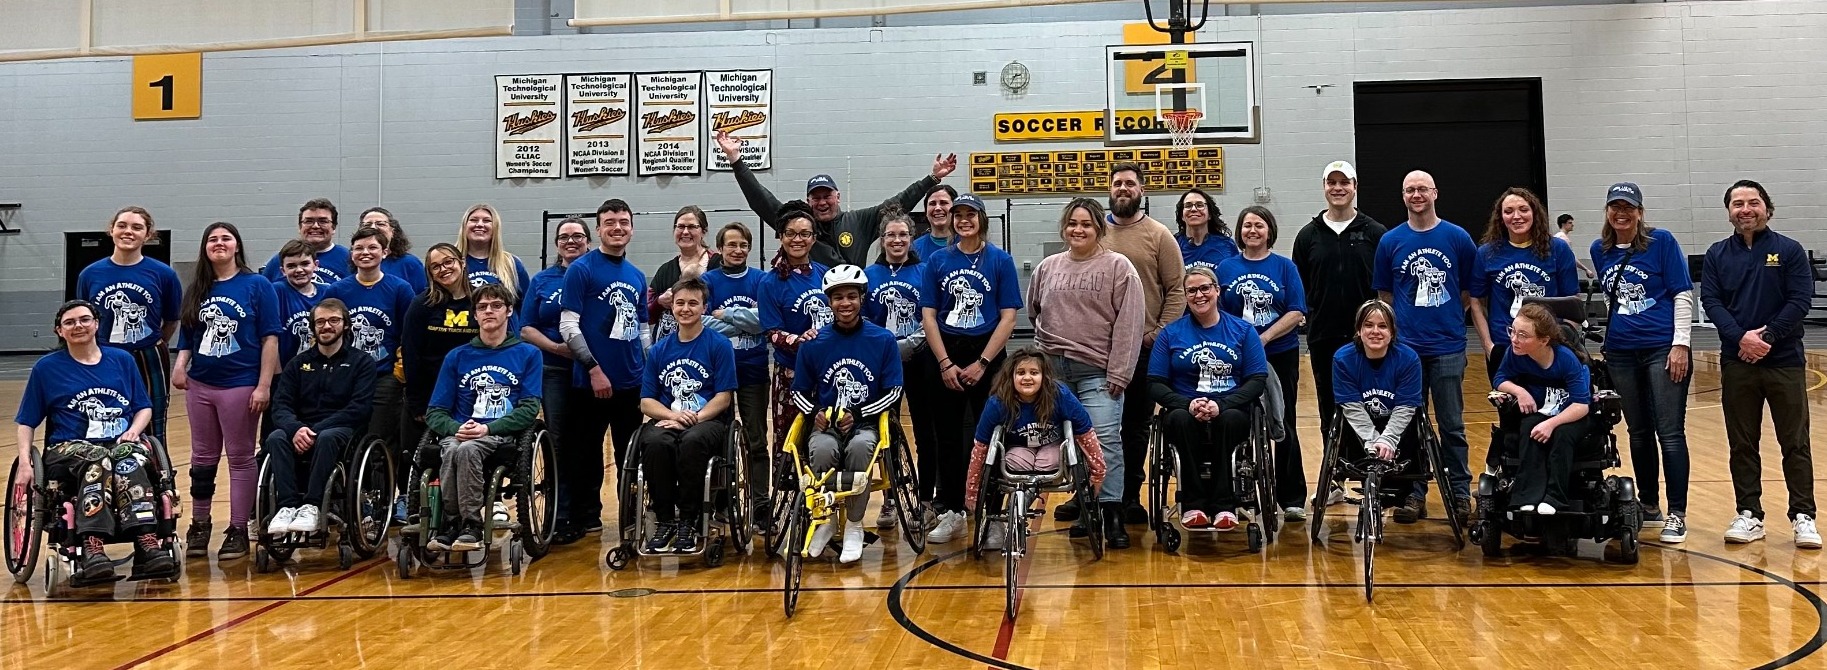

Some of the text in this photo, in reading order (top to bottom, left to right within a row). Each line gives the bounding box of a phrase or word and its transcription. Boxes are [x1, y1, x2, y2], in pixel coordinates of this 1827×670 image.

[720, 73, 757, 83] Michigan
[149, 75, 173, 110] 1
[710, 83, 767, 93] Technological
[718, 94, 759, 103] University
[502, 110, 557, 134] Huskies
[571, 106, 626, 130] Huskies
[641, 108, 695, 132] Huskies
[712, 110, 766, 132] Huskies
[998, 118, 1082, 134] SOCCER
[1401, 259, 1409, 270] AM
[1408, 252, 1417, 260] AN
[1417, 248, 1442, 259] ATHLETE
[1441, 256, 1452, 269] TOO
[1766, 253, 1779, 262] M
[942, 276, 951, 288] AM
[949, 270, 959, 278] AN
[959, 268, 982, 280] ATHLETE
[981, 278, 992, 292] TOO
[1497, 271, 1505, 280] AM
[1504, 265, 1514, 273] AN
[1514, 263, 1541, 273] ATHLETE
[1614, 264, 1636, 273] ATLETE
[1635, 269, 1648, 280] TOO
[872, 287, 881, 298] AM
[890, 280, 912, 290] ATHLETE
[1050, 271, 1106, 292] CHATEAU
[1247, 273, 1270, 282] ATHLETE
[1268, 280, 1280, 292] TOO
[96, 291, 105, 301] AM
[117, 282, 144, 293] ATHLETE
[144, 291, 153, 304] TOO
[602, 286, 611, 298] AM
[794, 297, 803, 309] AM
[800, 291, 808, 300] AN
[210, 296, 236, 307] ATHLETE
[234, 304, 246, 318] TOO
[724, 298, 733, 307] AN
[358, 306, 384, 317] ATHLETE
[381, 312, 392, 326] TOO
[444, 309, 469, 327] M
[1183, 348, 1194, 356] AM
[1202, 341, 1226, 350] ATHLETE
[1226, 347, 1238, 360] TOO
[461, 373, 471, 384] AM
[481, 365, 509, 375] ATHLETE
[506, 372, 519, 385] TOO
[658, 358, 709, 380] AM AN ATHLETE TOO
[824, 368, 833, 380] AM
[832, 360, 842, 370] AN
[840, 358, 864, 370] ATHLETE
[862, 367, 874, 382] TOO
[77, 391, 88, 400] AN
[88, 388, 117, 398] ATHLETE
[116, 394, 129, 406] TOO
[1362, 388, 1396, 400] AN ATHLETE
